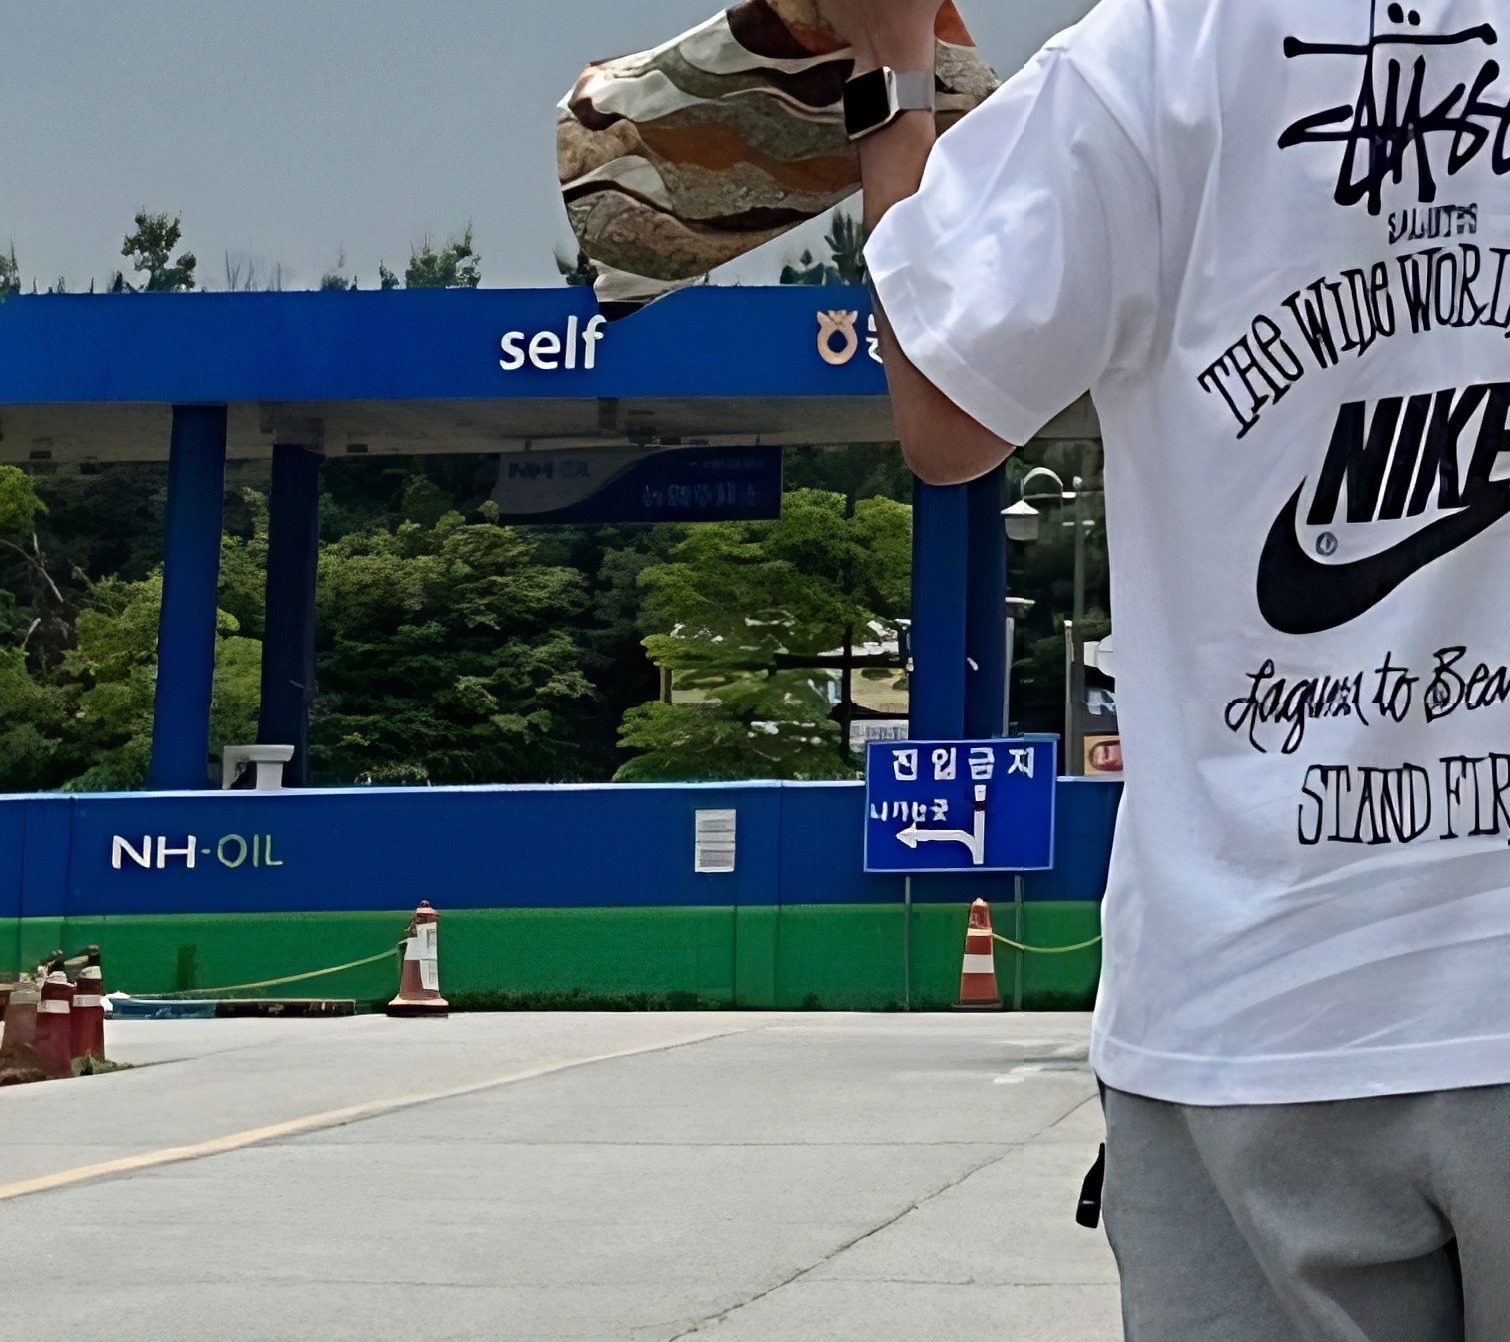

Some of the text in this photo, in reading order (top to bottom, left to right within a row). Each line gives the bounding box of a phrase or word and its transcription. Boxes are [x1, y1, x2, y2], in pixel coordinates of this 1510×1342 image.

[500, 314, 607, 370] self
[1373, 651, 1420, 723] to
[1298, 763, 1431, 845] STAND
